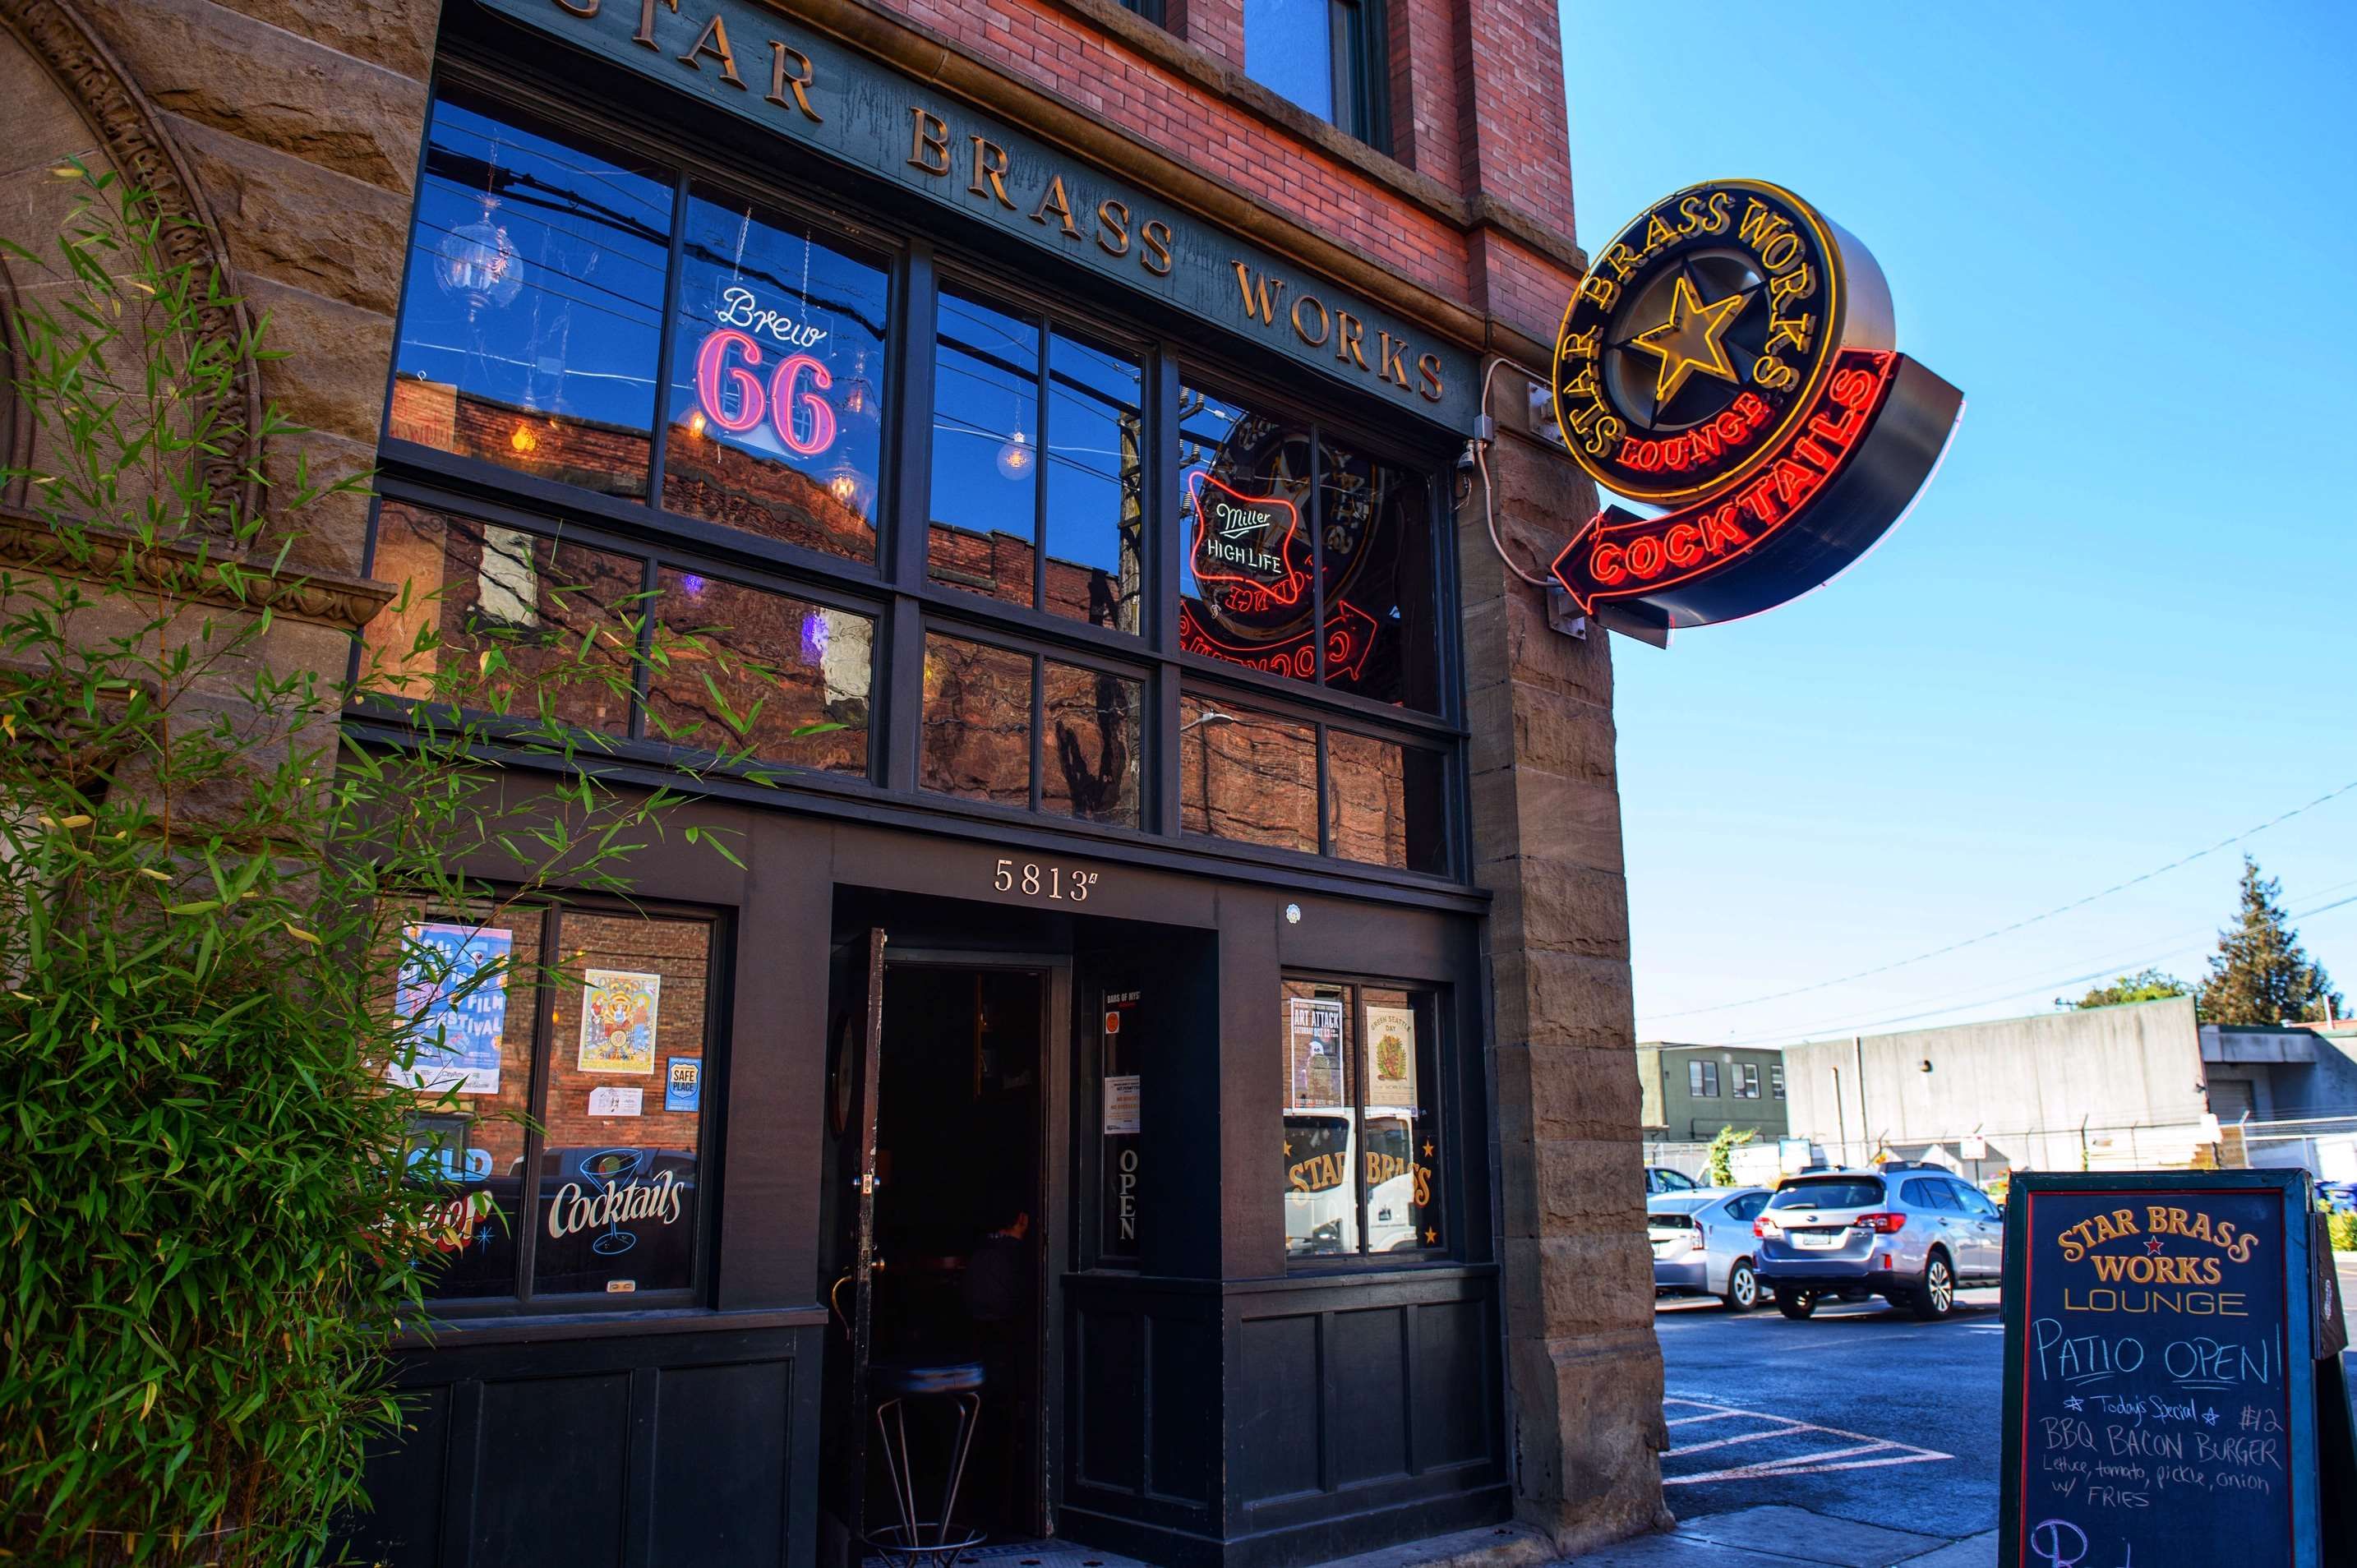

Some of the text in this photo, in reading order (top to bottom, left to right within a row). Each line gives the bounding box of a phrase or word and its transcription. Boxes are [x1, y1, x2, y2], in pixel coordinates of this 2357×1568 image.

[552, 0, 1442, 402] TAR BRASS WORKS
[717, 287, 828, 348] Brew
[1562, 192, 1816, 455] STAR BRASS WORKS
[698, 329, 837, 455] 66
[1616, 391, 1772, 472] LOUNGE
[1589, 367, 1878, 584] COCKTAILS
[1216, 503, 1271, 531] Miller
[1207, 539, 1282, 574] HIGH LIFE
[467, 994, 504, 1013] FILM
[1294, 1009, 1339, 1029] ART ATTACK
[1370, 1015, 1412, 1033] GREEN SEATTLE
[673, 1070, 694, 1082] SAFE
[673, 1081, 694, 1091] PLACE
[549, 1169, 685, 1239] Cocktails
[1119, 1150, 1138, 1239] OPEN
[2058, 1206, 2259, 1263] STAR BRASS
[2090, 1255, 2221, 1284] WORKS
[2064, 1288, 2249, 1317] LOUNGE
[2032, 1318, 2283, 1390] PATIO OPEN!
[2148, 1395, 2198, 1425] Special
[2238, 1404, 2284, 1432] #12
[2040, 1417, 2283, 1470] BBQ BACON BURGER
[2087, 1486, 2150, 1509] FRIES
